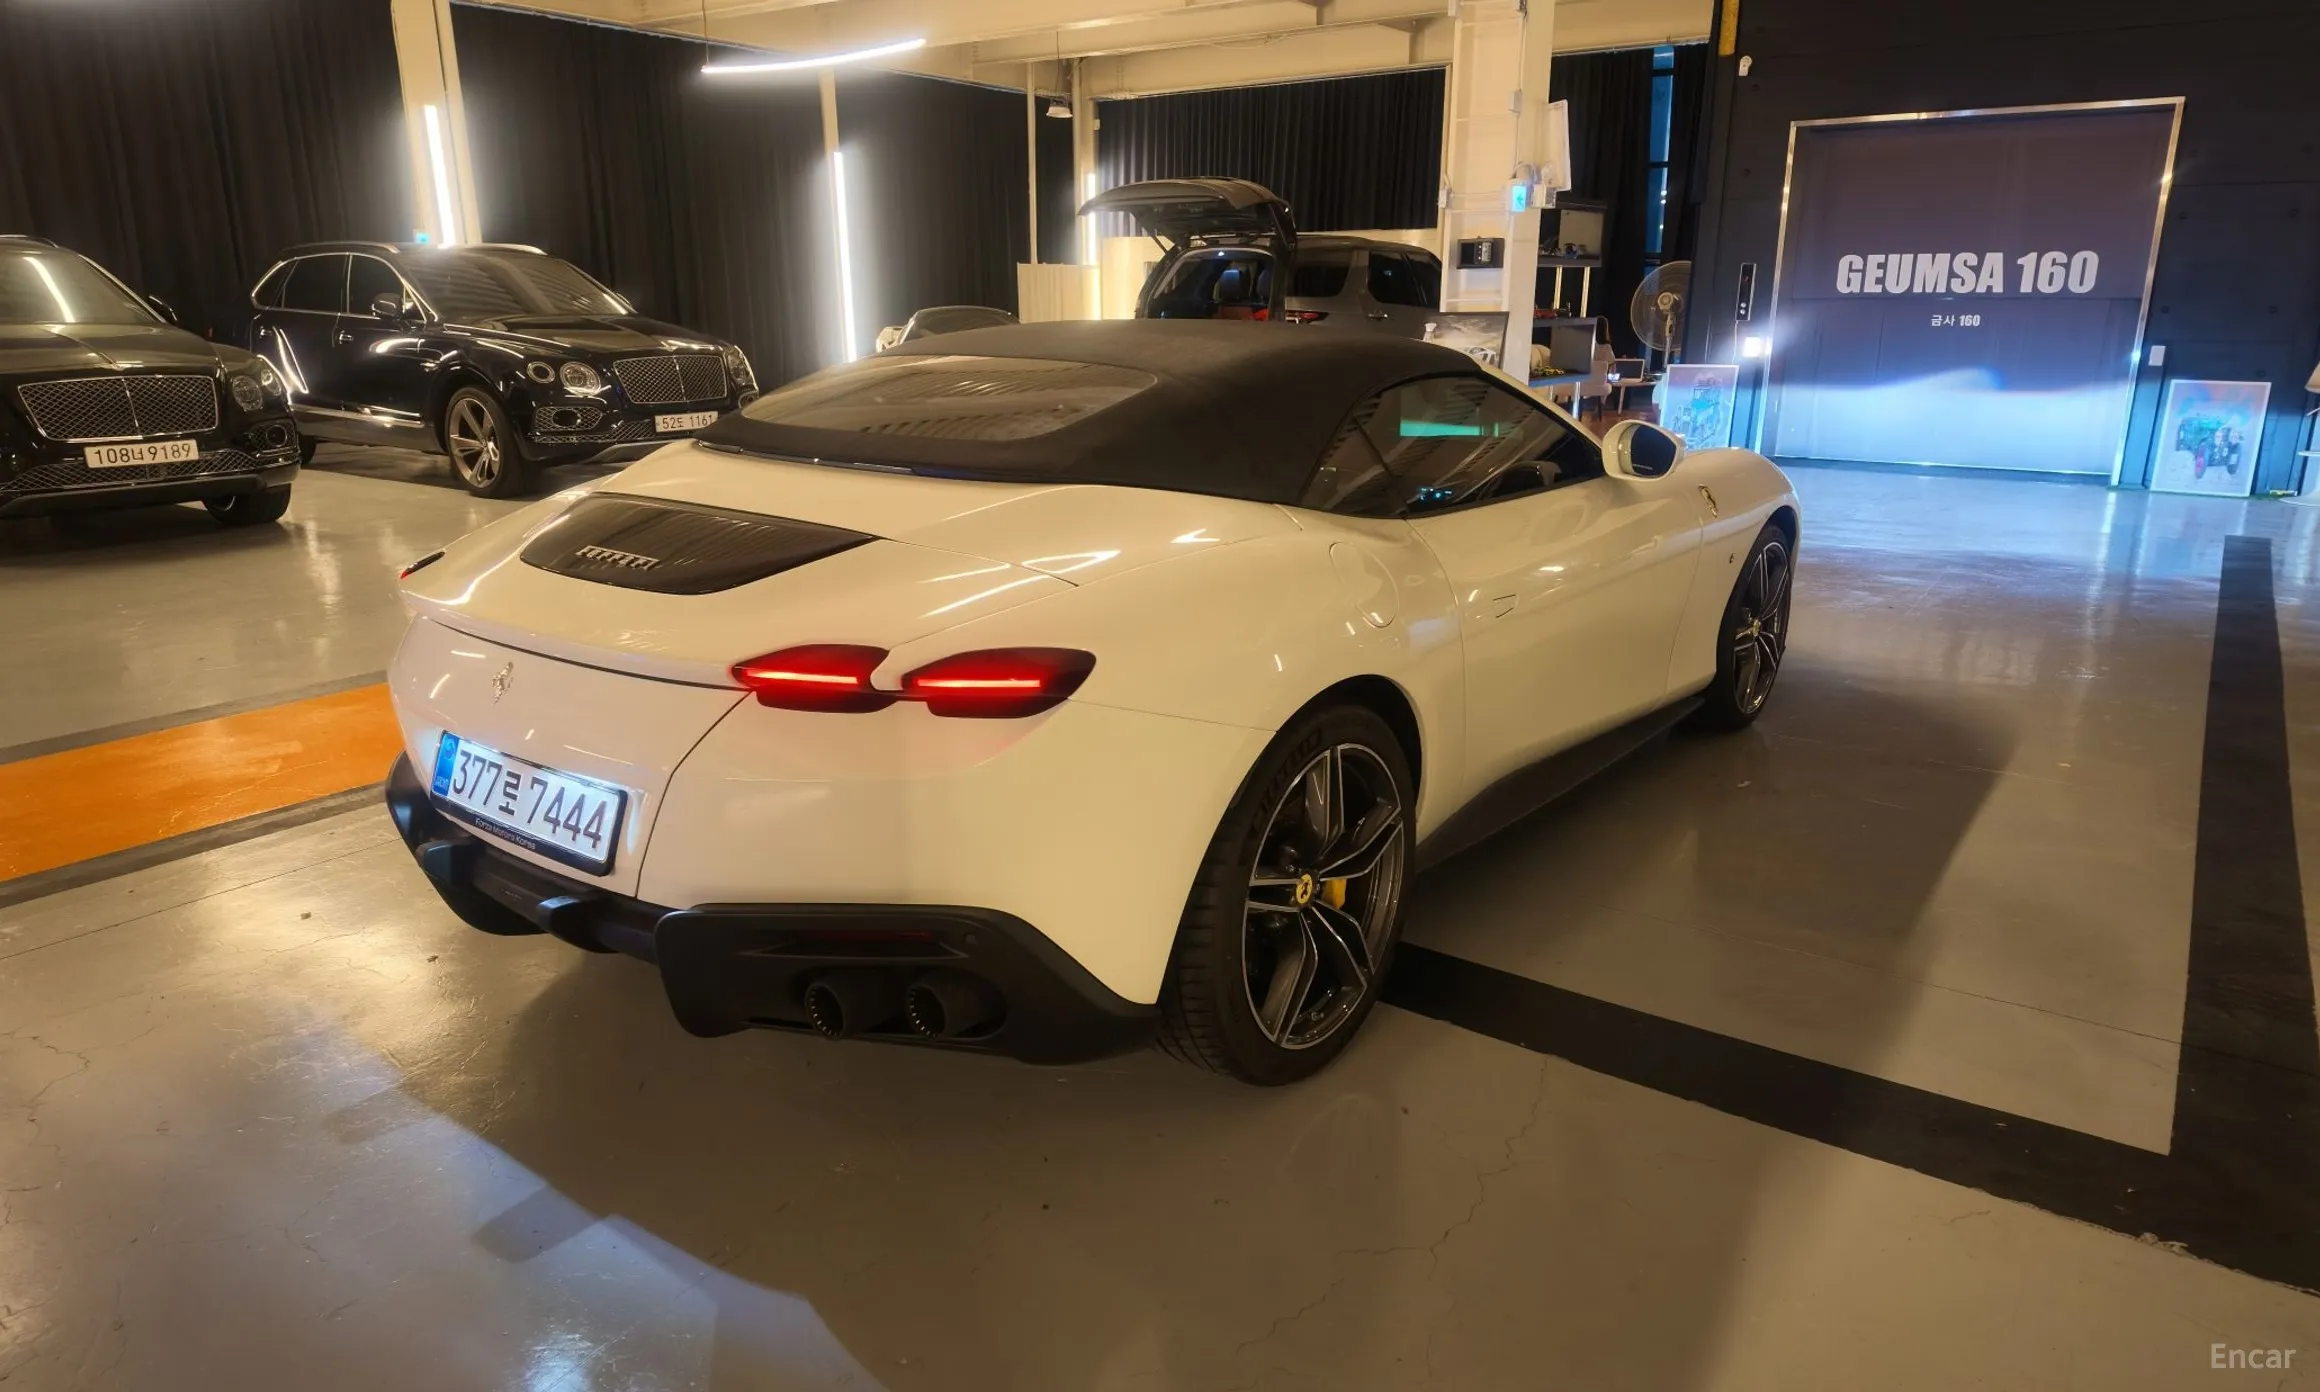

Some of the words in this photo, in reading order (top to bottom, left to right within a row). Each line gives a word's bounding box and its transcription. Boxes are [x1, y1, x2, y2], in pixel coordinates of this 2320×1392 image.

[1836, 252, 2004, 294] GEUMSA
[2017, 250, 2099, 294] 160
[1930, 313, 1956, 327] 금사
[1959, 314, 1981, 327] 160
